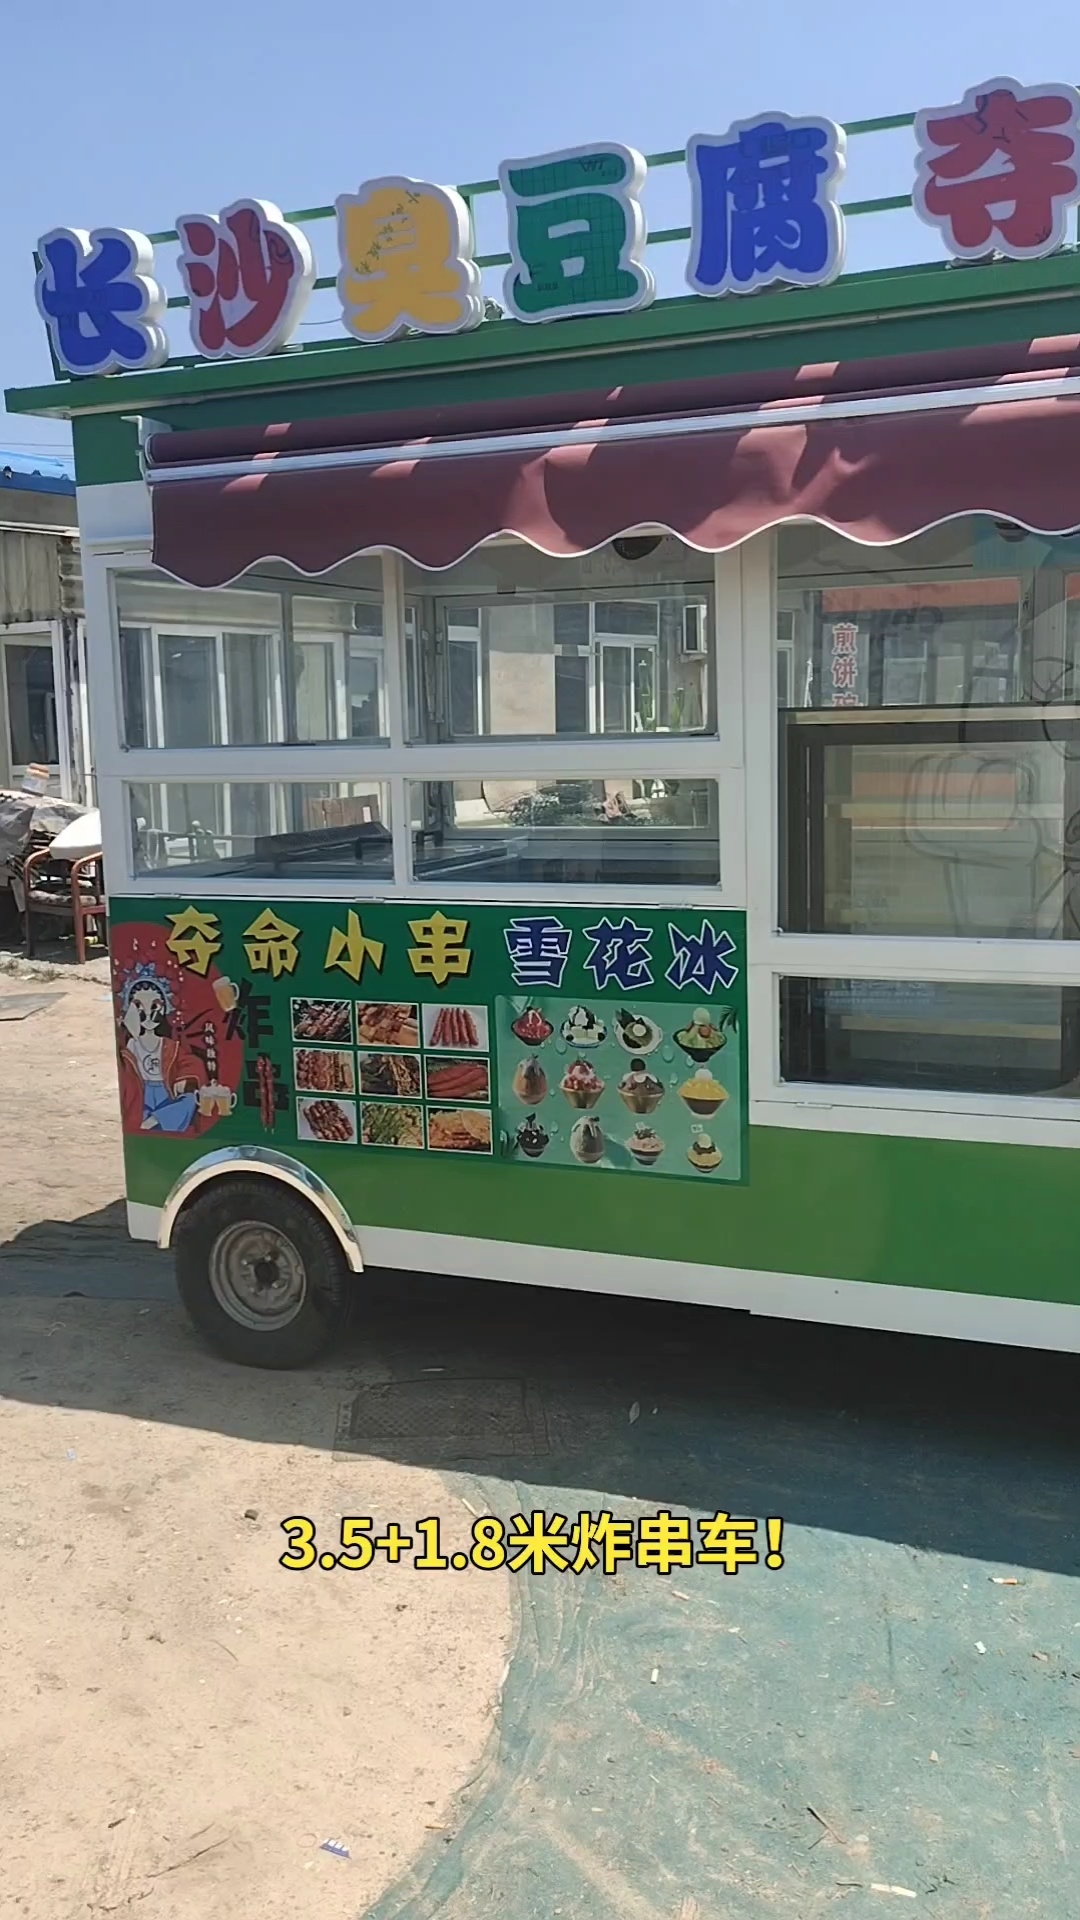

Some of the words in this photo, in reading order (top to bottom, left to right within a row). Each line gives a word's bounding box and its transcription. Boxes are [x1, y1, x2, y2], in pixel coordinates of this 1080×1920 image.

[38, 82, 1080, 371] 长沙臭豆腐夺
[165, 905, 472, 986] 夺命小串
[503, 916, 740, 995] 雪花冰
